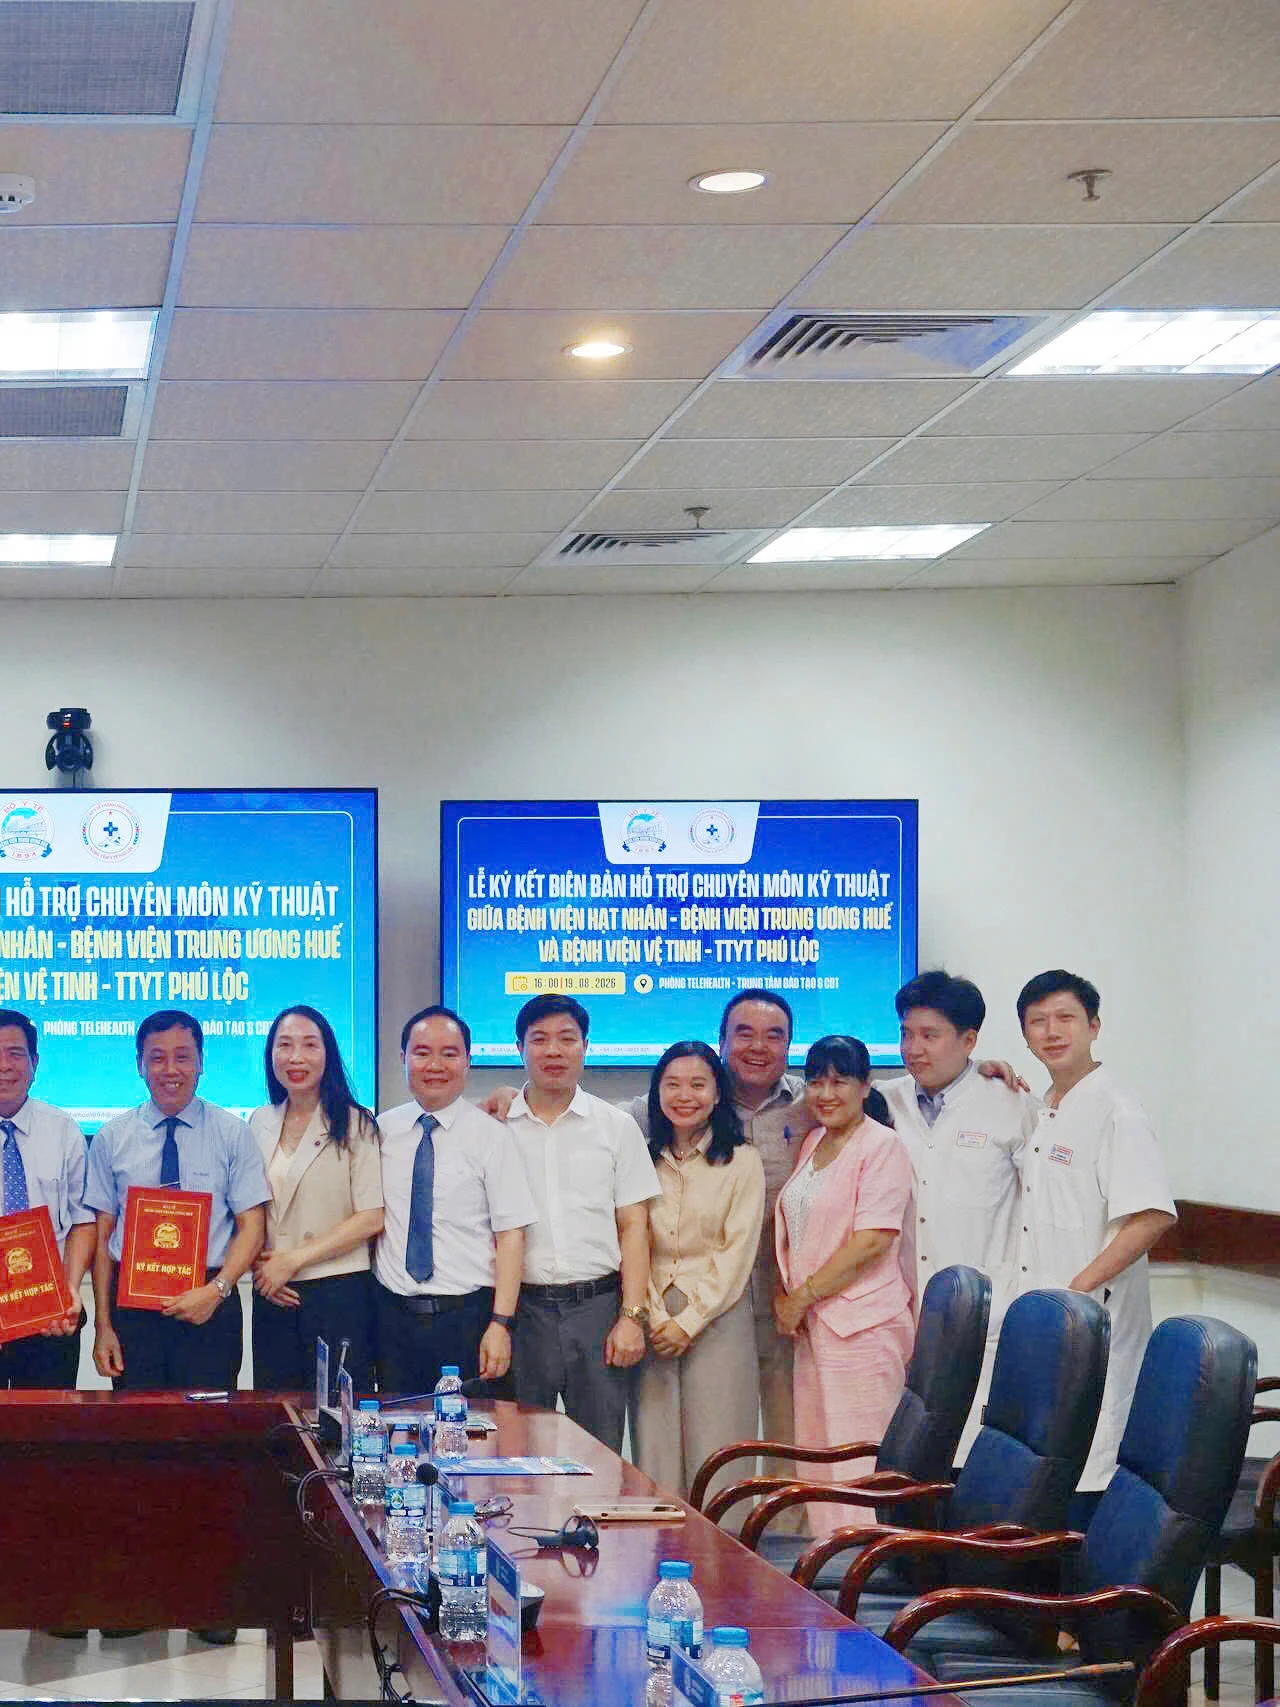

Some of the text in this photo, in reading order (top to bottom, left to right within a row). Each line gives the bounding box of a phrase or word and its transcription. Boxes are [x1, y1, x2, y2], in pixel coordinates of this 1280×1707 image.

[6, 876, 34, 917] HỖ
[39, 884, 81, 922] TRỢ
[86, 881, 170, 917] CHUYÊN
[177, 880, 228, 917] MÔN
[234, 881, 264, 917] KỸ
[268, 880, 339, 921] THUẬT
[469, 867, 890, 901] LỄ KÝ KẾT BIÊN BẢN HỖ TRỢ CHUYÊN MÔN KỸ THUẬT
[467, 904, 503, 930] GIỮA
[507, 904, 547, 934] BỆNH
[550, 904, 585, 934] VIỆN
[587, 908, 619, 934] HẠT
[622, 904, 667, 931] NHÂN
[680, 904, 720, 934] BỆNH
[723, 904, 759, 934] VIỆN
[761, 907, 813, 930] TRUNG
[817, 906, 860, 930] ƯƠNG
[863, 901, 894, 930] HUẾ
[71, 925, 123, 964] BỆNH
[126, 925, 171, 964] VIỆN
[175, 929, 241, 959] TRUNG
[246, 928, 300, 959] ƯƠNG
[305, 922, 344, 959] HUẾ
[538, 936, 559, 962] VÀ
[562, 936, 602, 966] BỆNH
[605, 936, 640, 966] VIỆN
[644, 936, 663, 966] VỆ
[665, 940, 701, 962] TINH
[715, 940, 753, 962] TTYT
[756, 936, 787, 962] PHÚ
[790, 936, 819, 966] LỘC
[23, 967, 48, 1005] VỆ
[51, 971, 98, 1001] TINH
[114, 971, 165, 1001] TTYT
[168, 967, 209, 1001] PHÚ
[212, 967, 249, 1005] LỘC
[43, 1019, 135, 1036] PHÒNG TELEHEALTH
[225, 1021, 245, 1039] TẠO
